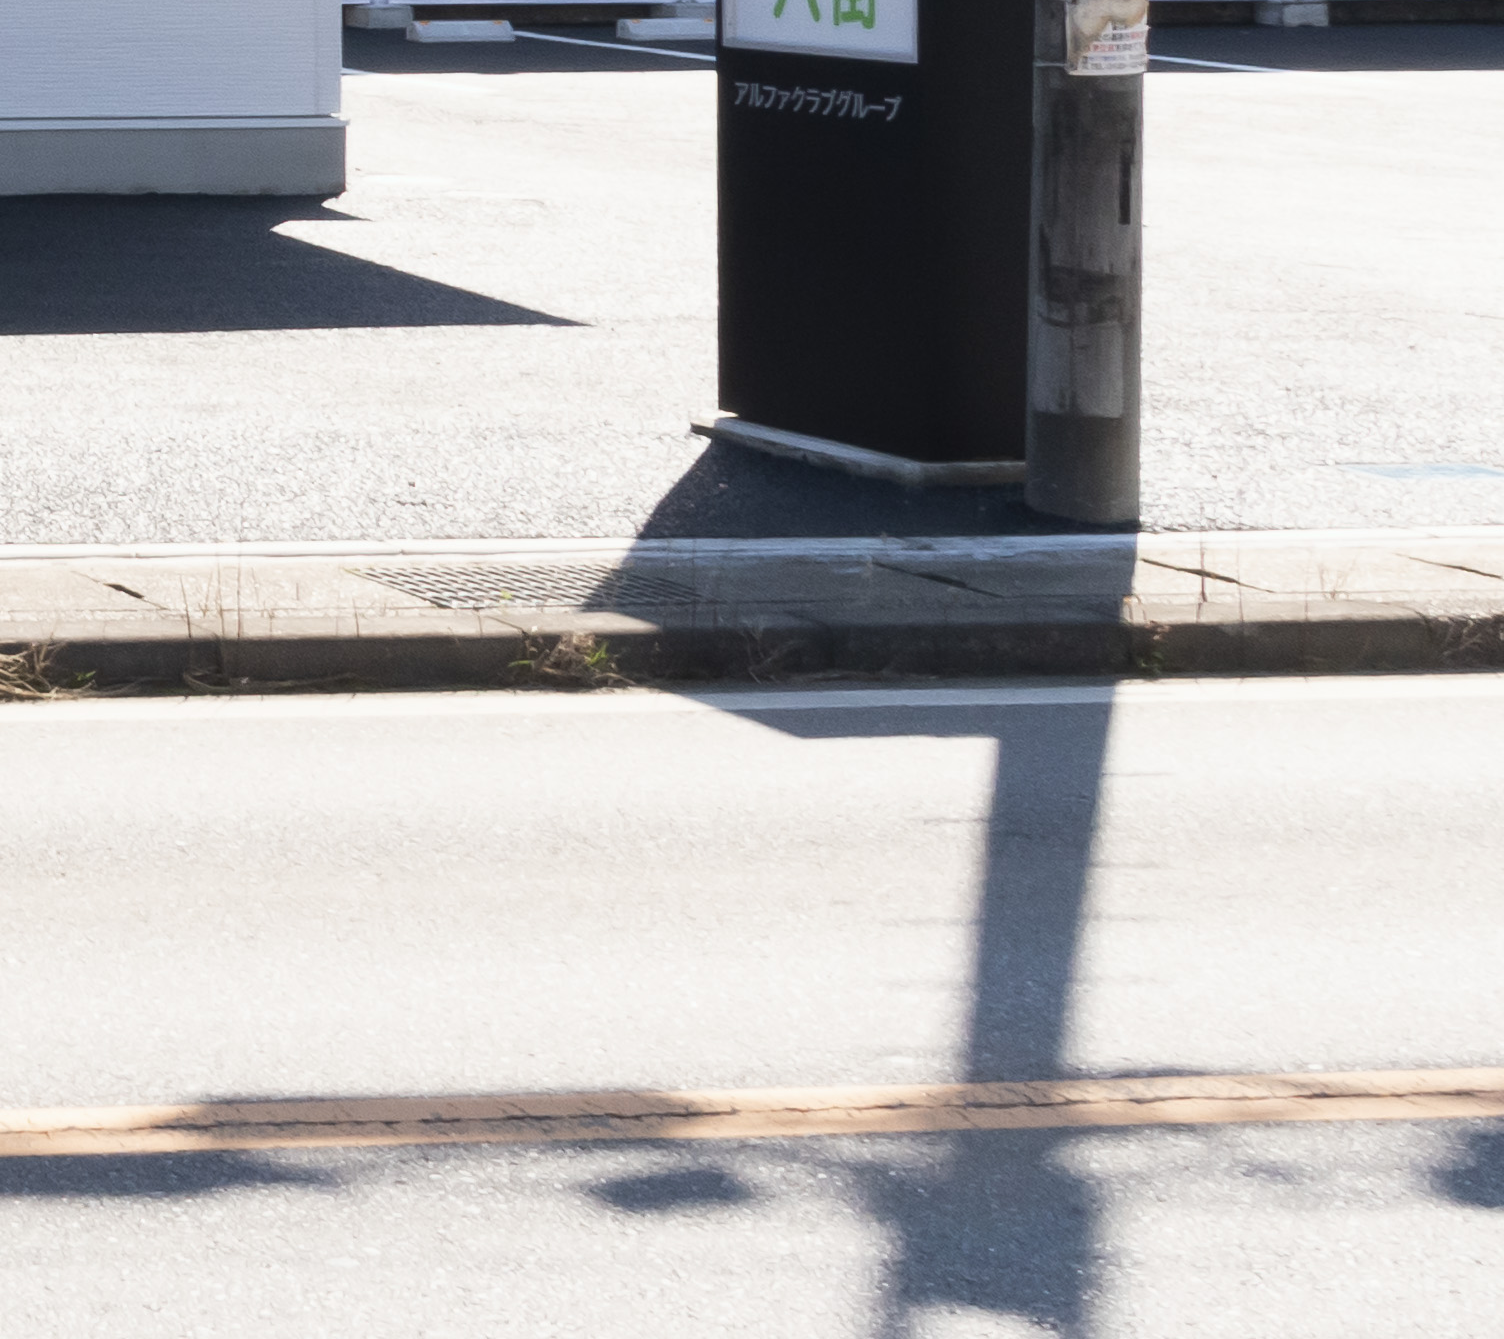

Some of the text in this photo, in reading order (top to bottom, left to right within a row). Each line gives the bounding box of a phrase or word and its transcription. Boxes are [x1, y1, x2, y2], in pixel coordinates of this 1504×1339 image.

[734, 81, 904, 122] アルファクラブグループ
